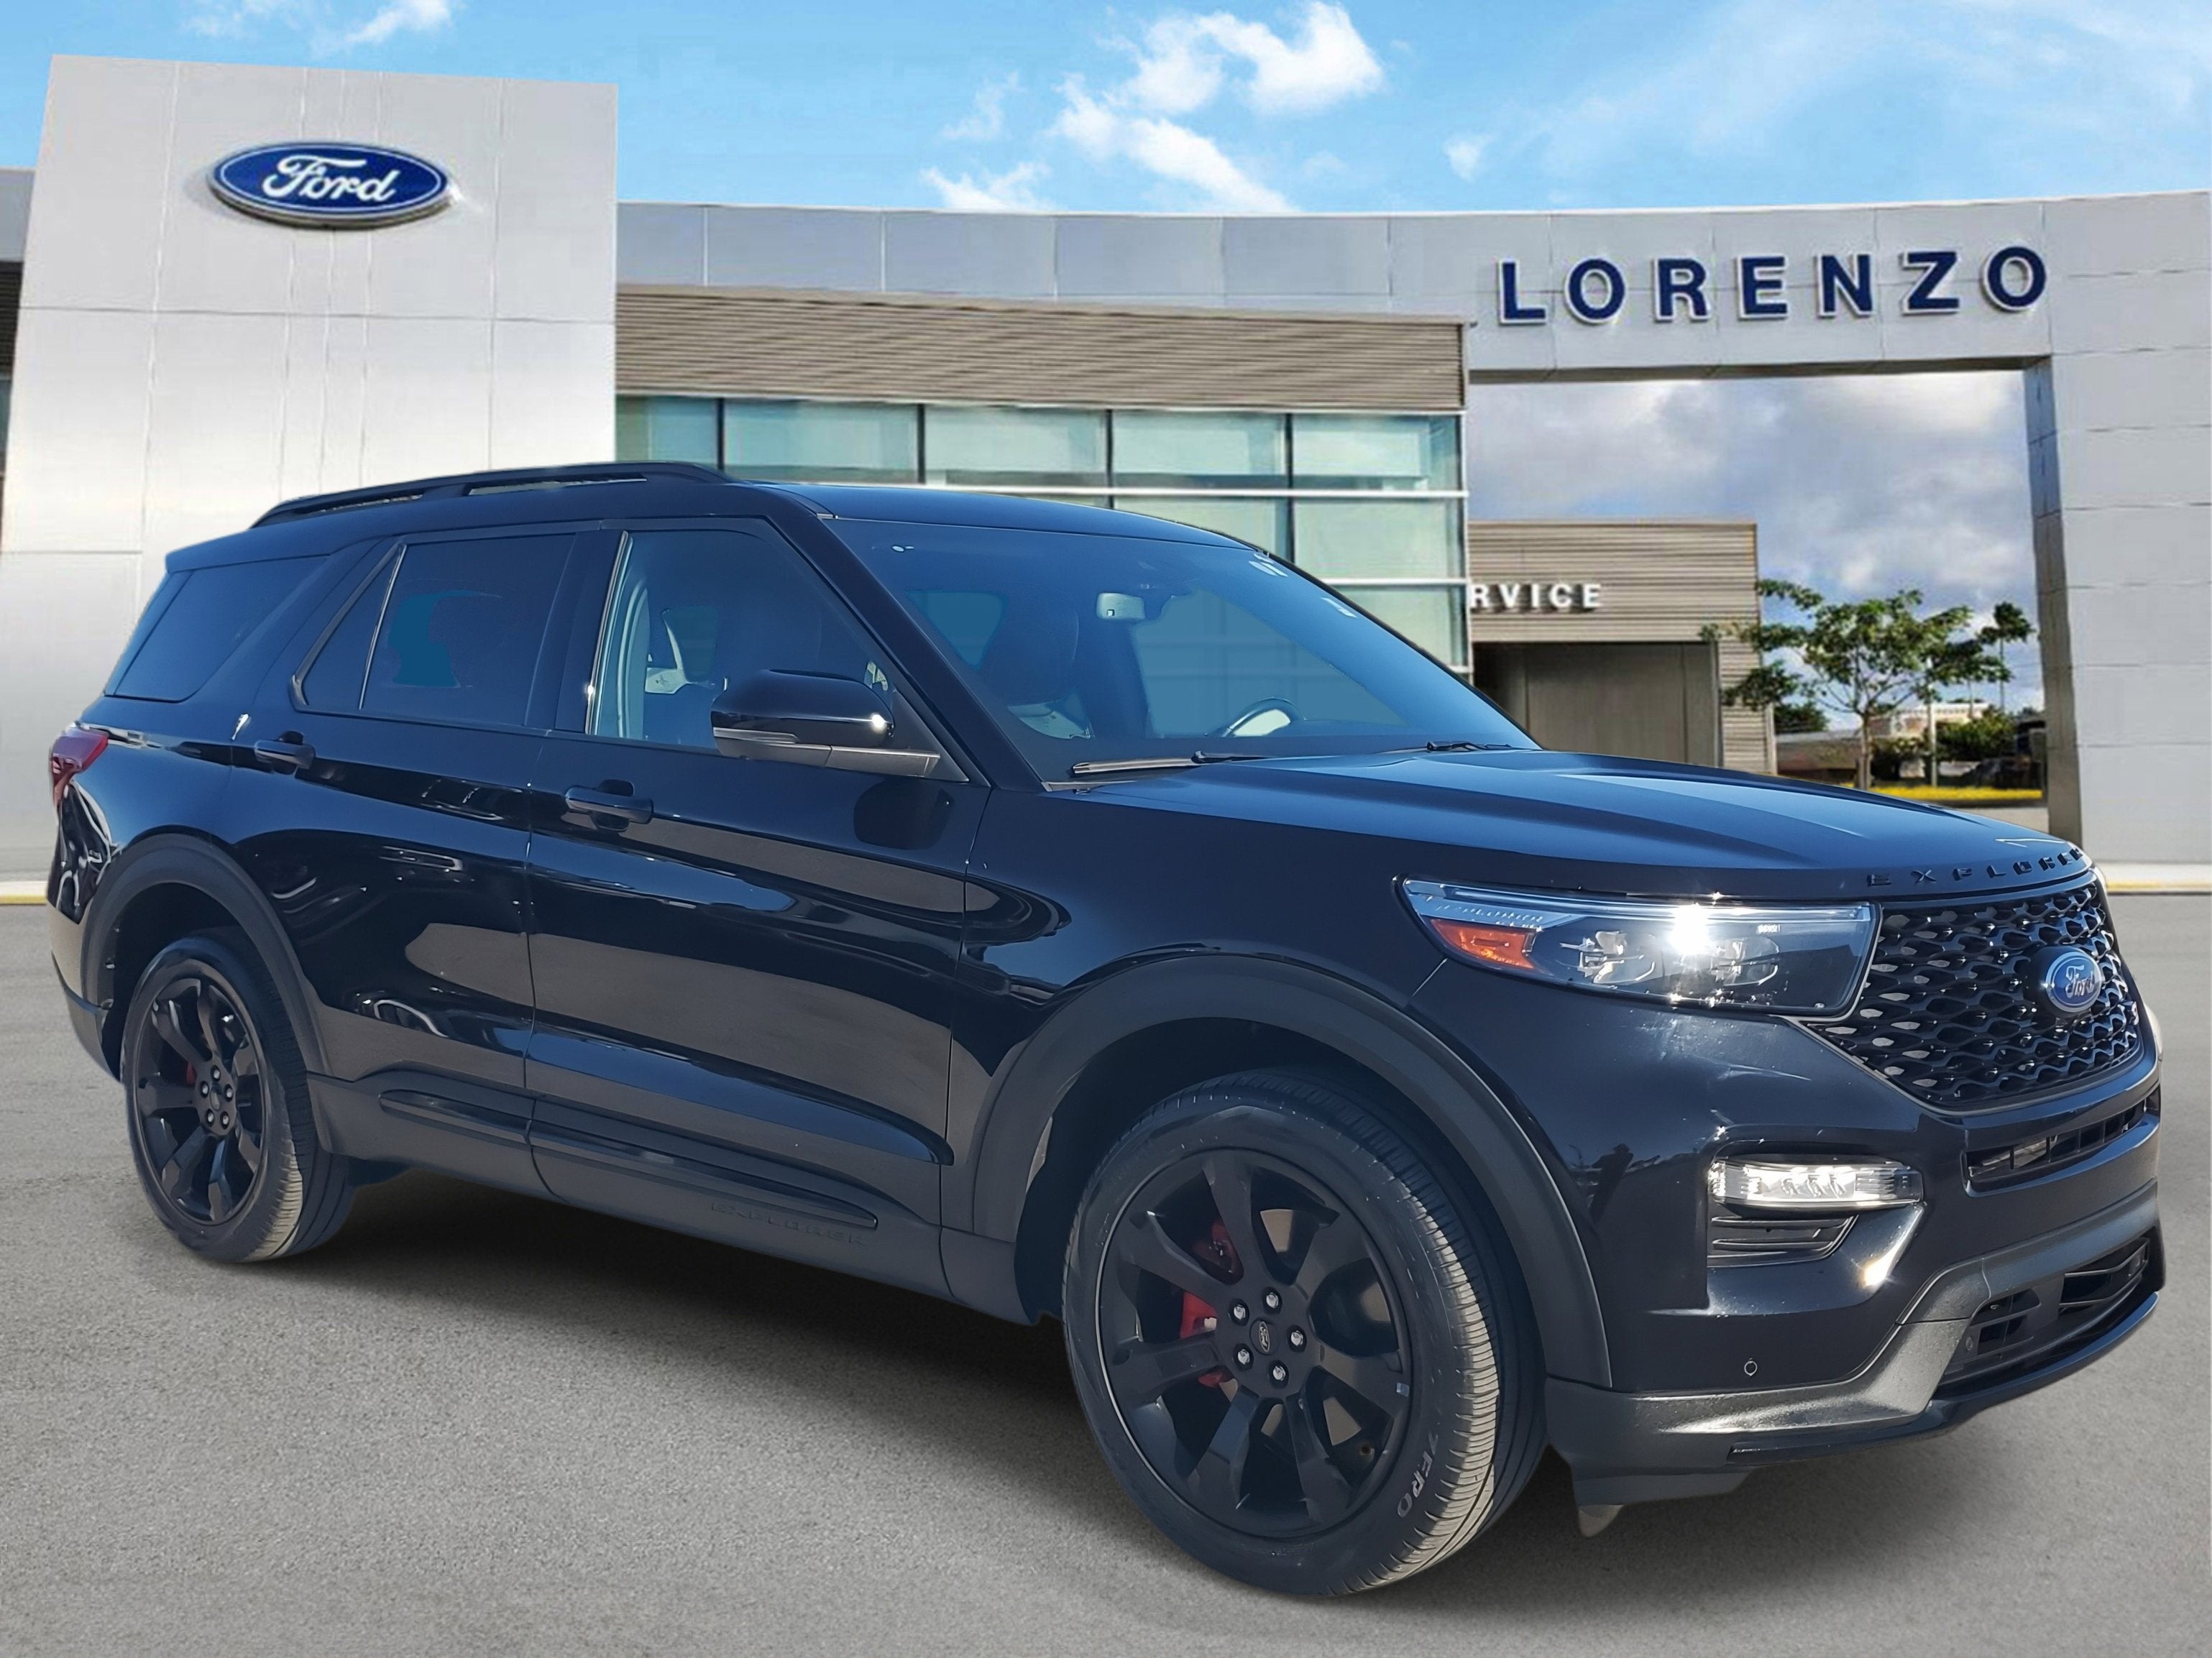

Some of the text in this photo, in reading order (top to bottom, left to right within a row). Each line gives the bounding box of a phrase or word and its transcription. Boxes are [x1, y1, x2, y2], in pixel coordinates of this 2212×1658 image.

[262, 155, 400, 201] Ford
[1498, 245, 2047, 326] LORENZO
[2065, 964, 2095, 998] Ford
